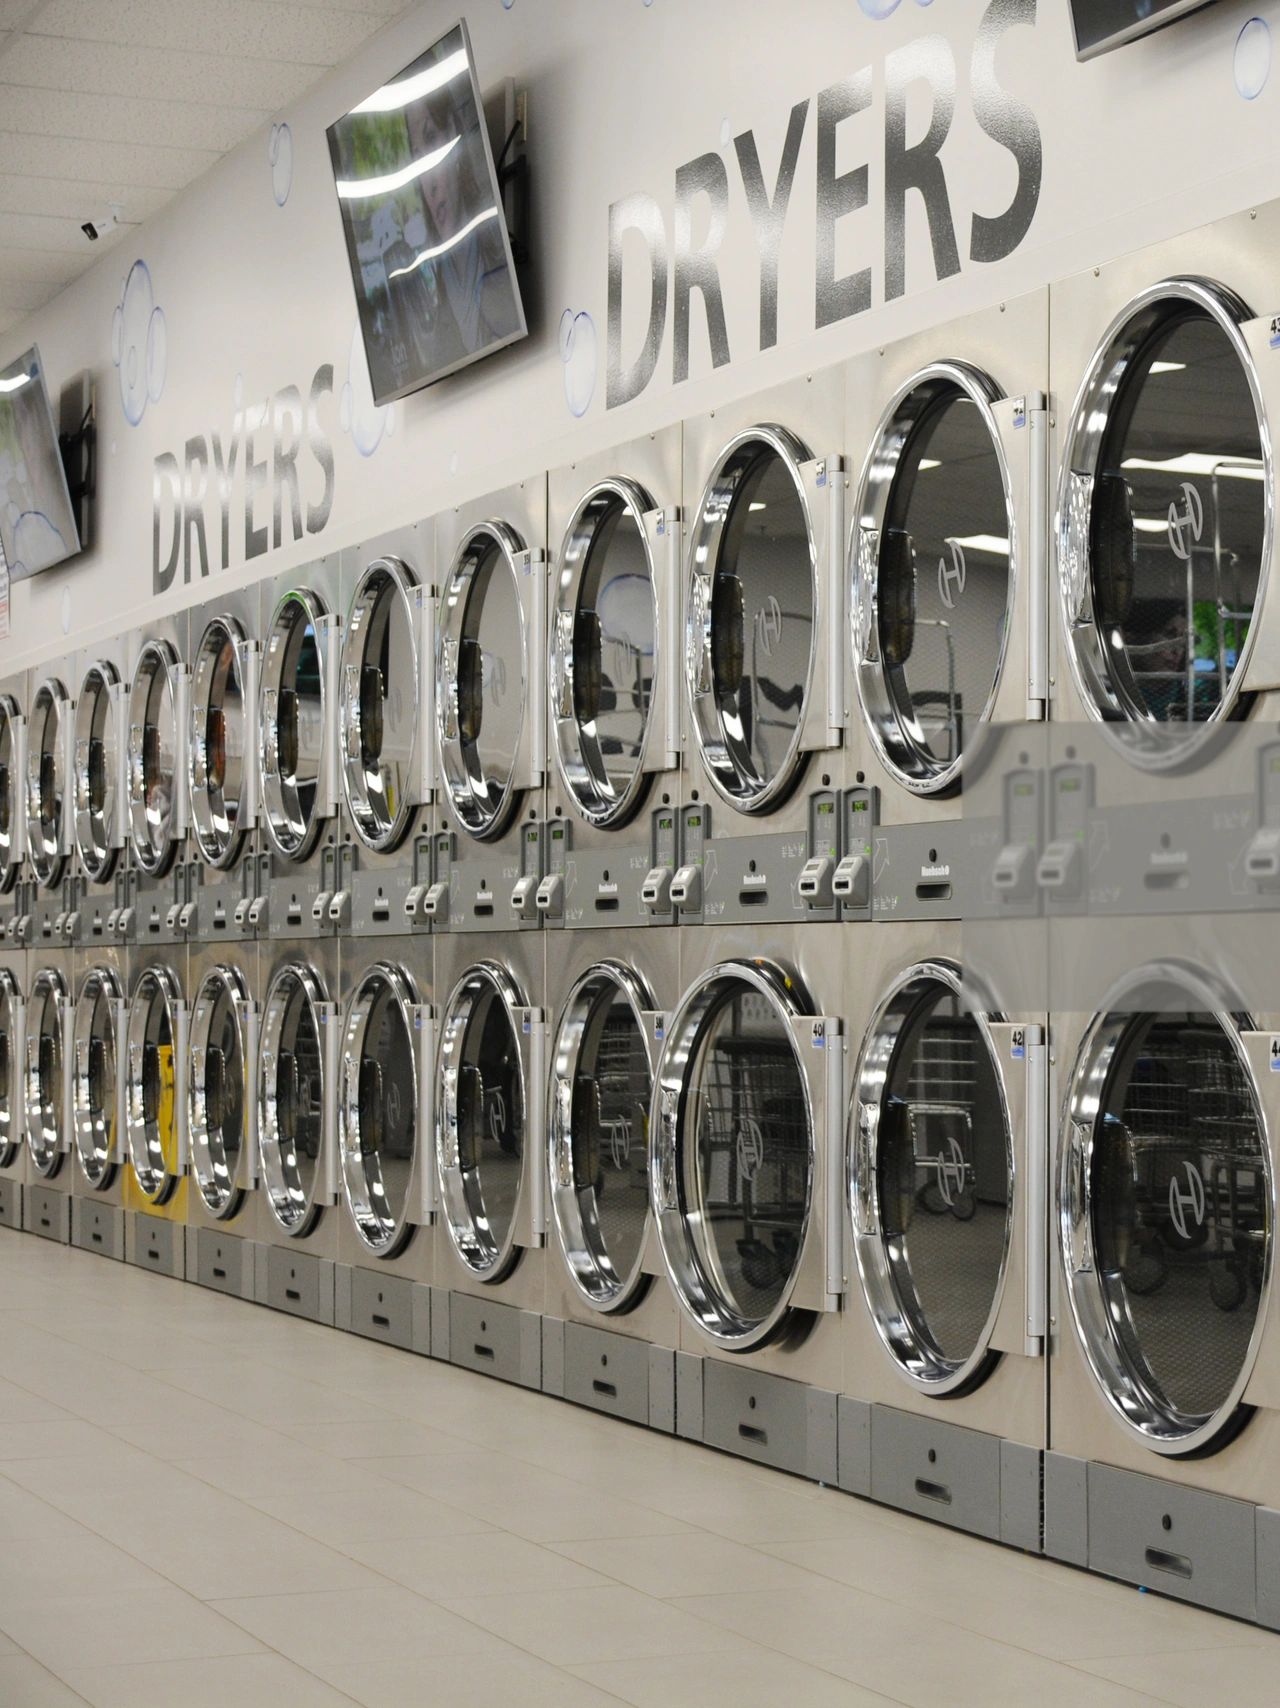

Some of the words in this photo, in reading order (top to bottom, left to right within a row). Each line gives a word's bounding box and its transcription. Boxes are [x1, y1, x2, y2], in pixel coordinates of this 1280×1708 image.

[606, 0, 1044, 410] DRYERS
[153, 363, 334, 596] DRYERS
[813, 1023, 822, 1036] 40
[1012, 1031, 1022, 1046] 42
